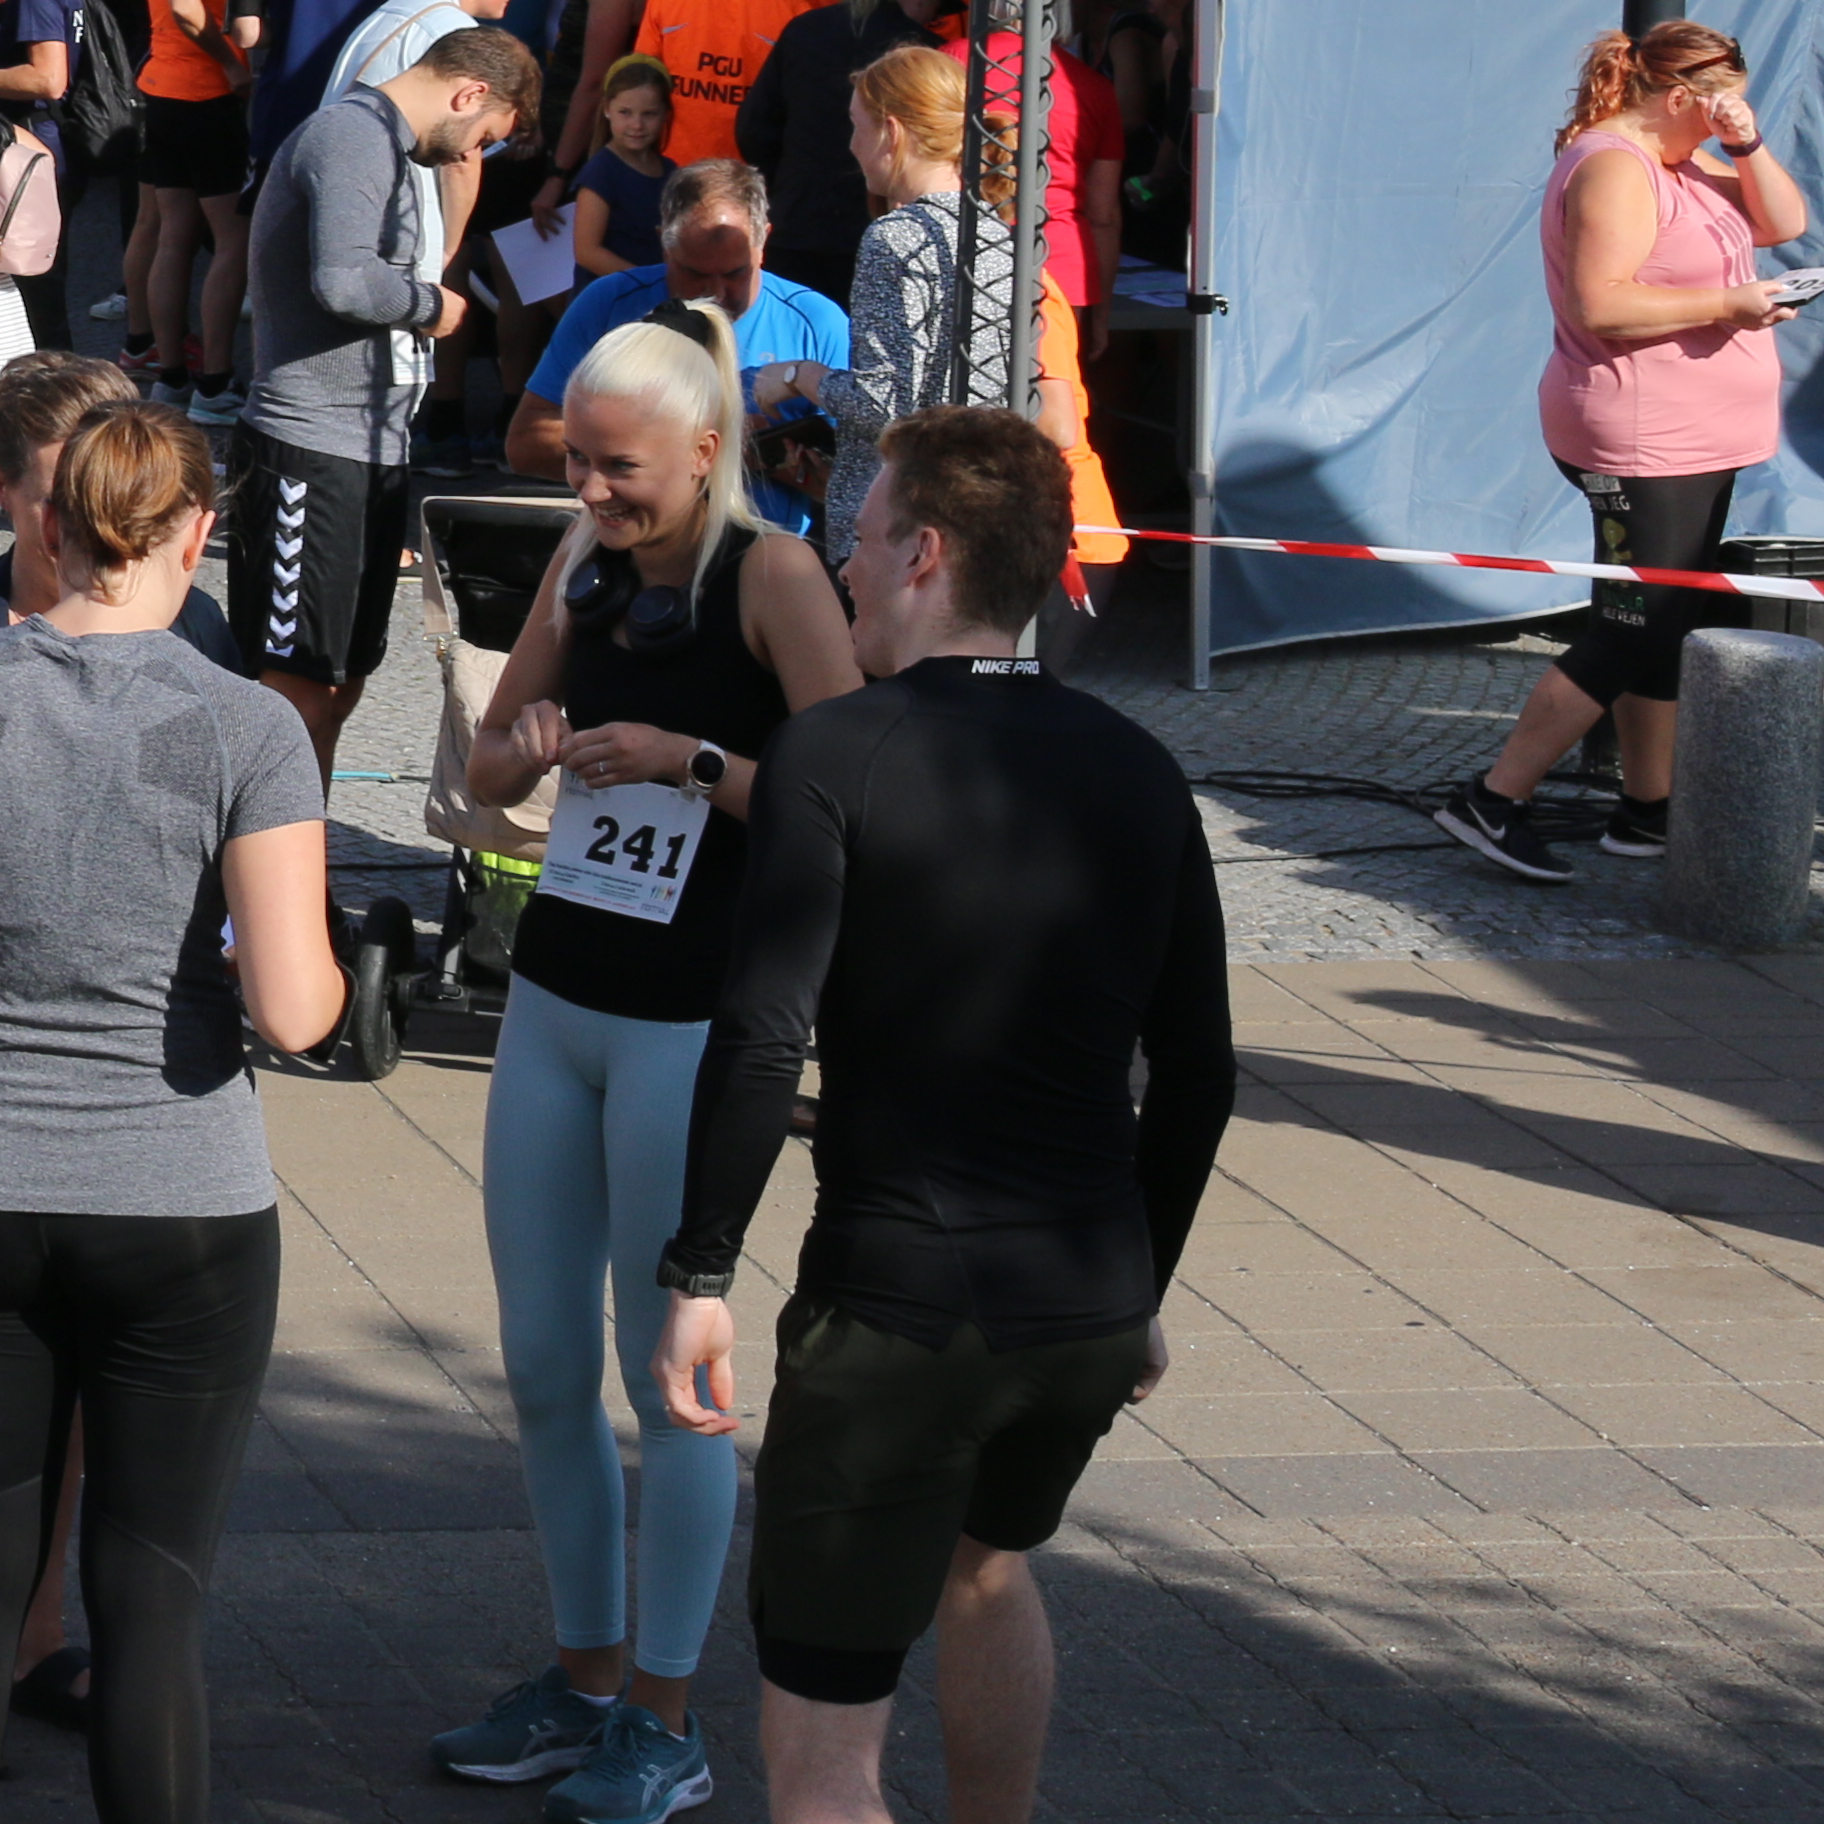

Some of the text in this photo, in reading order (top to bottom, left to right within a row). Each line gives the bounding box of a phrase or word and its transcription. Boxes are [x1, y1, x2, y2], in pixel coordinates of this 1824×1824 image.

[697, 51, 743, 78] PGU
[671, 74, 752, 106] RUNNE
[971, 659, 1040, 675] NIKE PRO
[584, 814, 687, 880] 241
